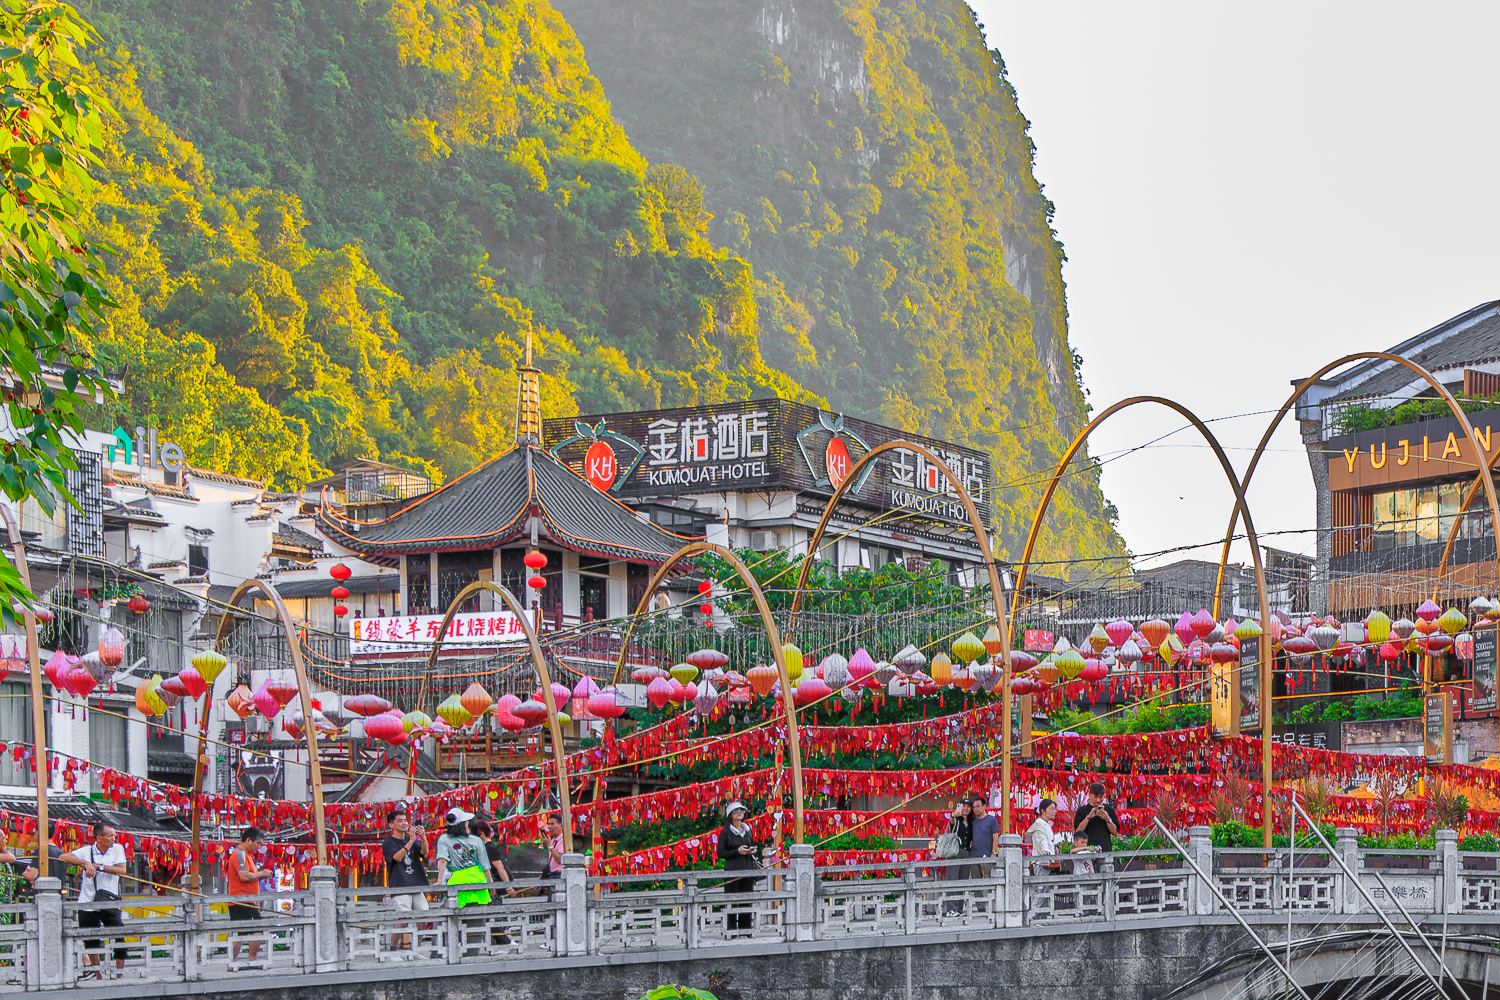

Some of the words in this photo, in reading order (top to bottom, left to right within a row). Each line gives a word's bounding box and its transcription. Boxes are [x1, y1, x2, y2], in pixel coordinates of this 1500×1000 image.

[648, 411, 769, 466] 金桔酒店
[1343, 425, 1491, 473] YUJIAN
[590, 455, 613, 482] KH
[649, 465, 719, 486] KUMQUAT
[721, 461, 770, 480] HOTEL
[829, 454, 847, 482] KH
[891, 440, 984, 504] 金桔酒店
[891, 489, 948, 516] KUMQUAT
[949, 503, 980, 521] HOT
[1369, 886, 1428, 899] 百樂橋
